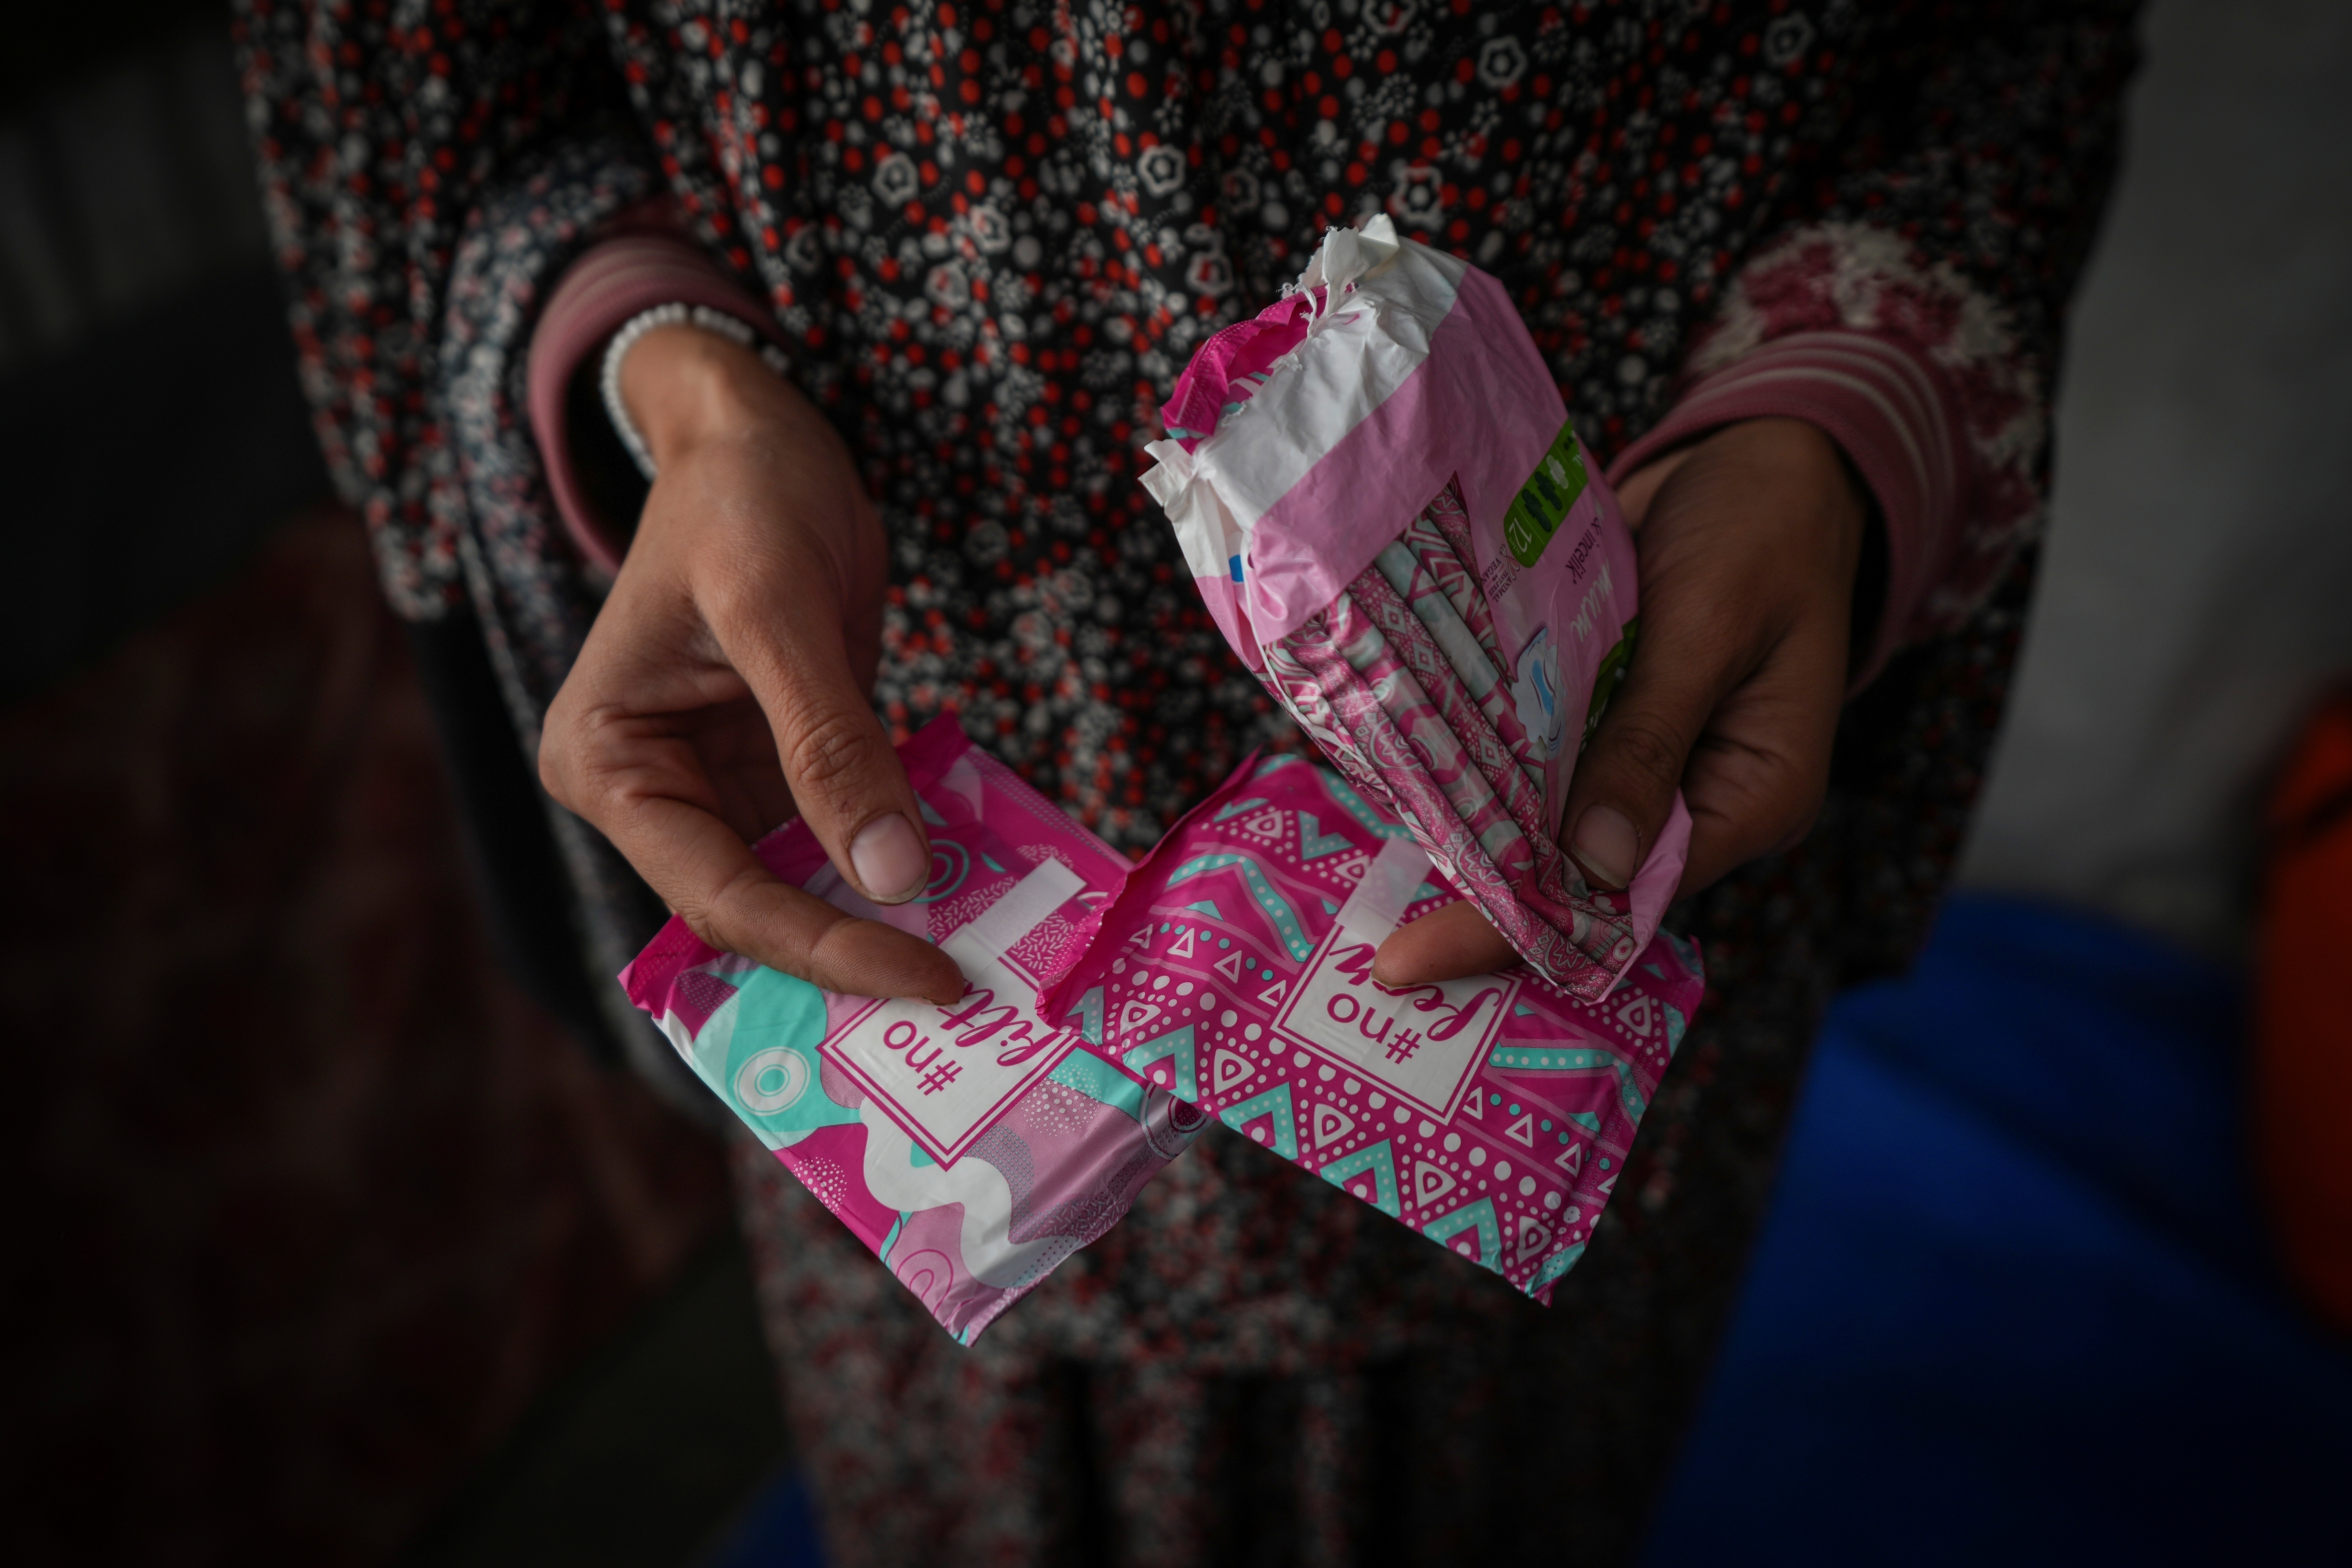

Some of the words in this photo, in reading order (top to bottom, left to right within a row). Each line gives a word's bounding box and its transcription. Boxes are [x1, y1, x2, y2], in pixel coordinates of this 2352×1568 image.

[1509, 517, 1532, 553] 12
[1488, 570, 1508, 596] TEST-FREE
[1492, 575, 1512, 603] ANIMAL
[1327, 993, 1420, 1065] #no
[883, 1020, 963, 1096] #no
